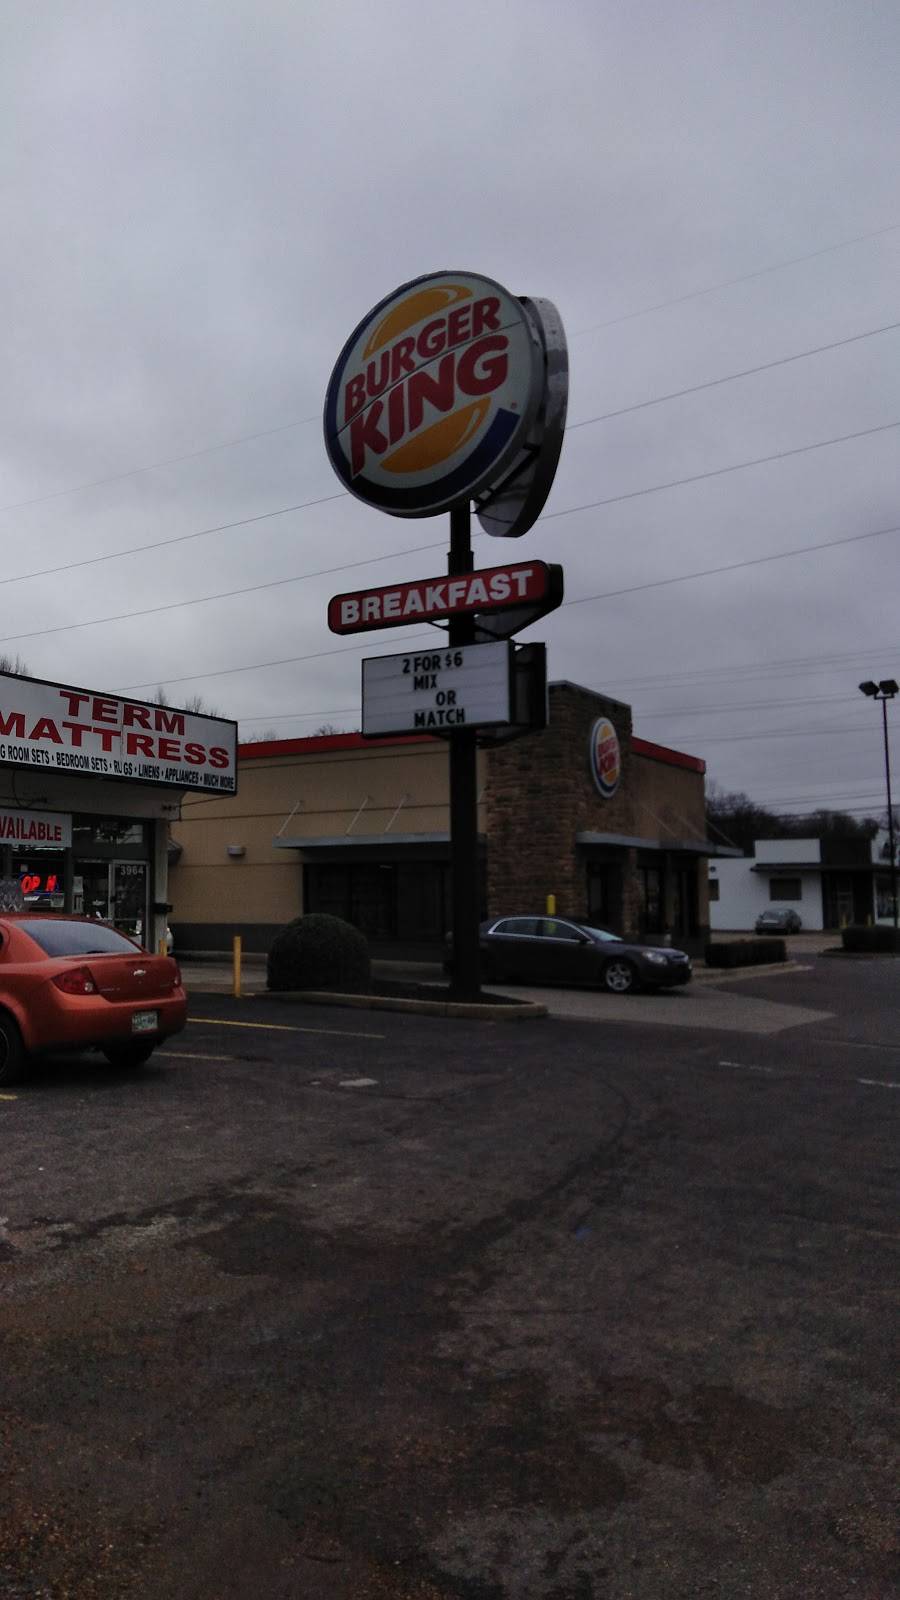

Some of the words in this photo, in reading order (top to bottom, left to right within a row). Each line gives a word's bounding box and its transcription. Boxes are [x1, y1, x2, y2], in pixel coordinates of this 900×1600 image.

[344, 297, 501, 424] BURGER
[350, 335, 509, 476] KING
[341, 569, 534, 625] BREAKFAST
[402, 658, 411, 674] 2
[414, 654, 441, 672] FOR
[445, 651, 463, 668] $6
[414, 674, 438, 690] MIX
[60, 690, 185, 736] TERM
[414, 708, 465, 727] MATCH
[436, 689, 457, 706] OR
[0, 711, 230, 769] MATTRESS
[8, 745, 30, 761] ROOM
[32, 748, 50, 765] SETS
[56, 752, 90, 768] BEDROOM
[91, 757, 108, 772] SETS
[138, 763, 160, 779] LINENS
[165, 767, 199, 784] APPLIANCES
[203, 773, 219, 787] MUCH
[220, 774, 234, 789] MORE
